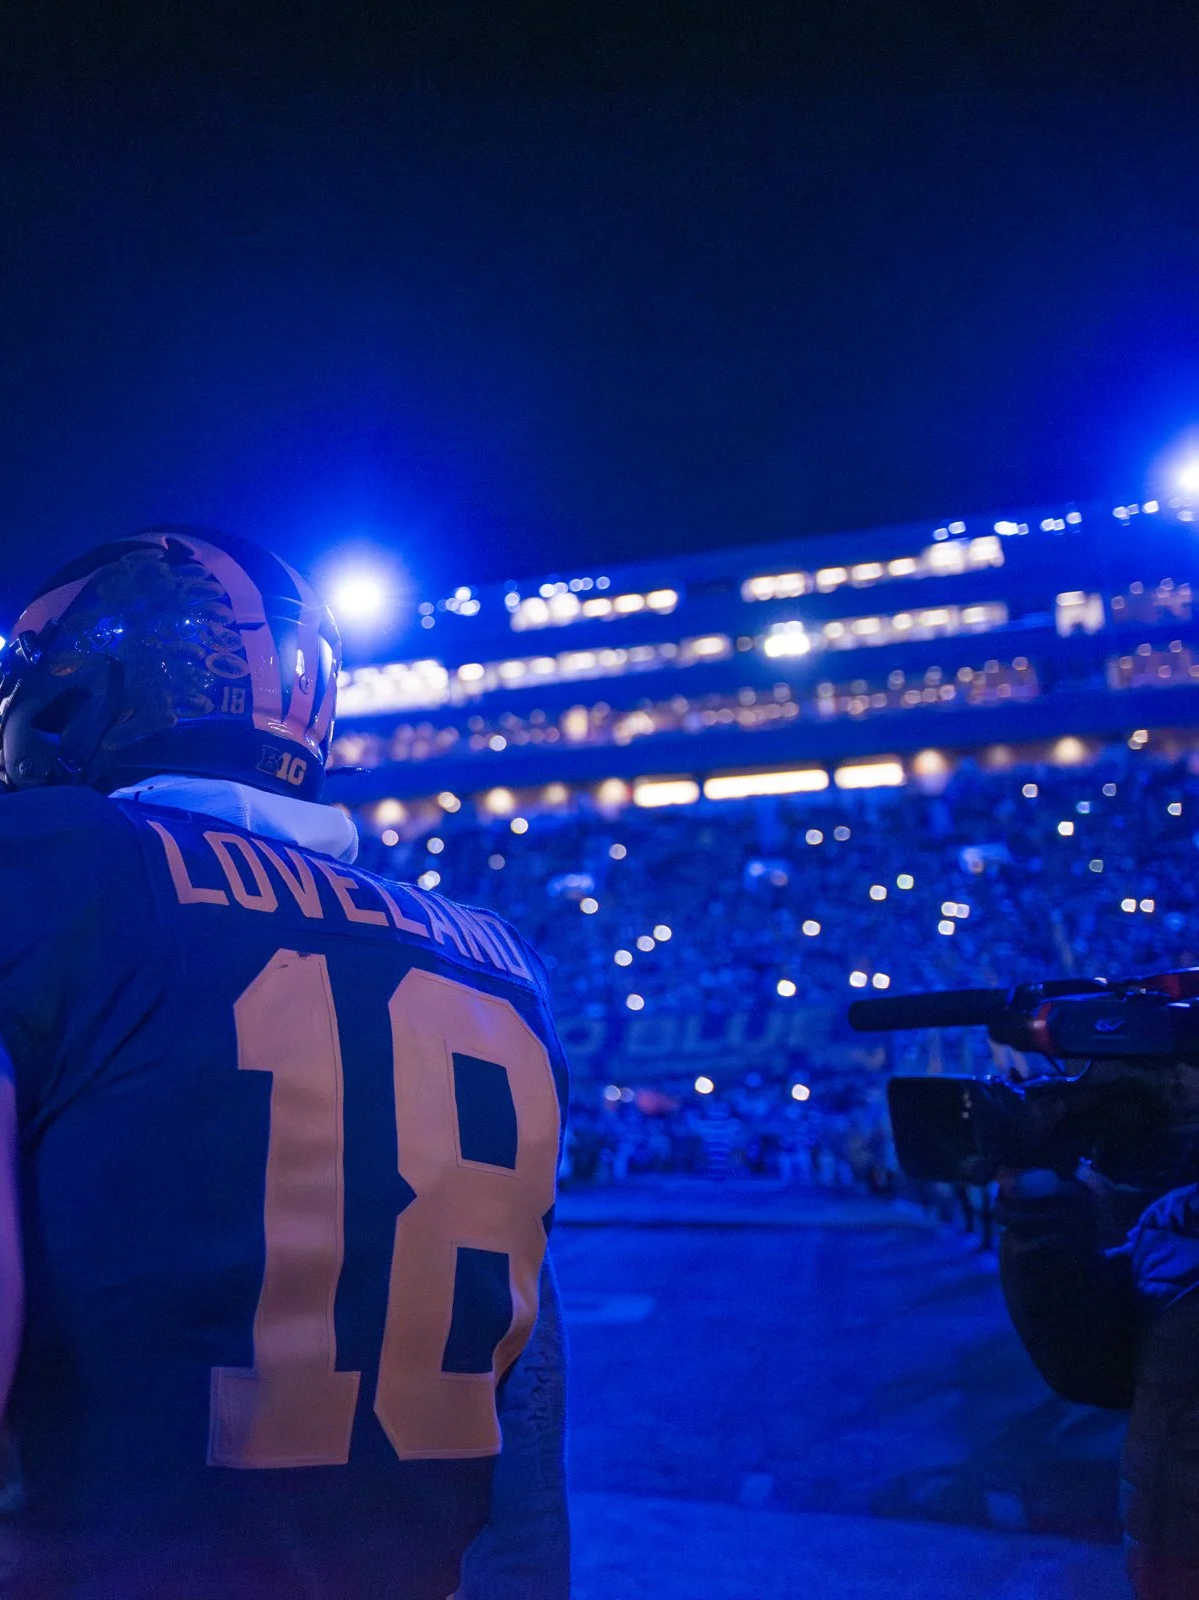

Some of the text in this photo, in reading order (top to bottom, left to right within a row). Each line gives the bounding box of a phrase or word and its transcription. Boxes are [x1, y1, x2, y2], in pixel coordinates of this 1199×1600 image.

[219, 685, 247, 715] 18
[145, 819, 535, 984] LOVELAND
[206, 947, 562, 1470] 18
